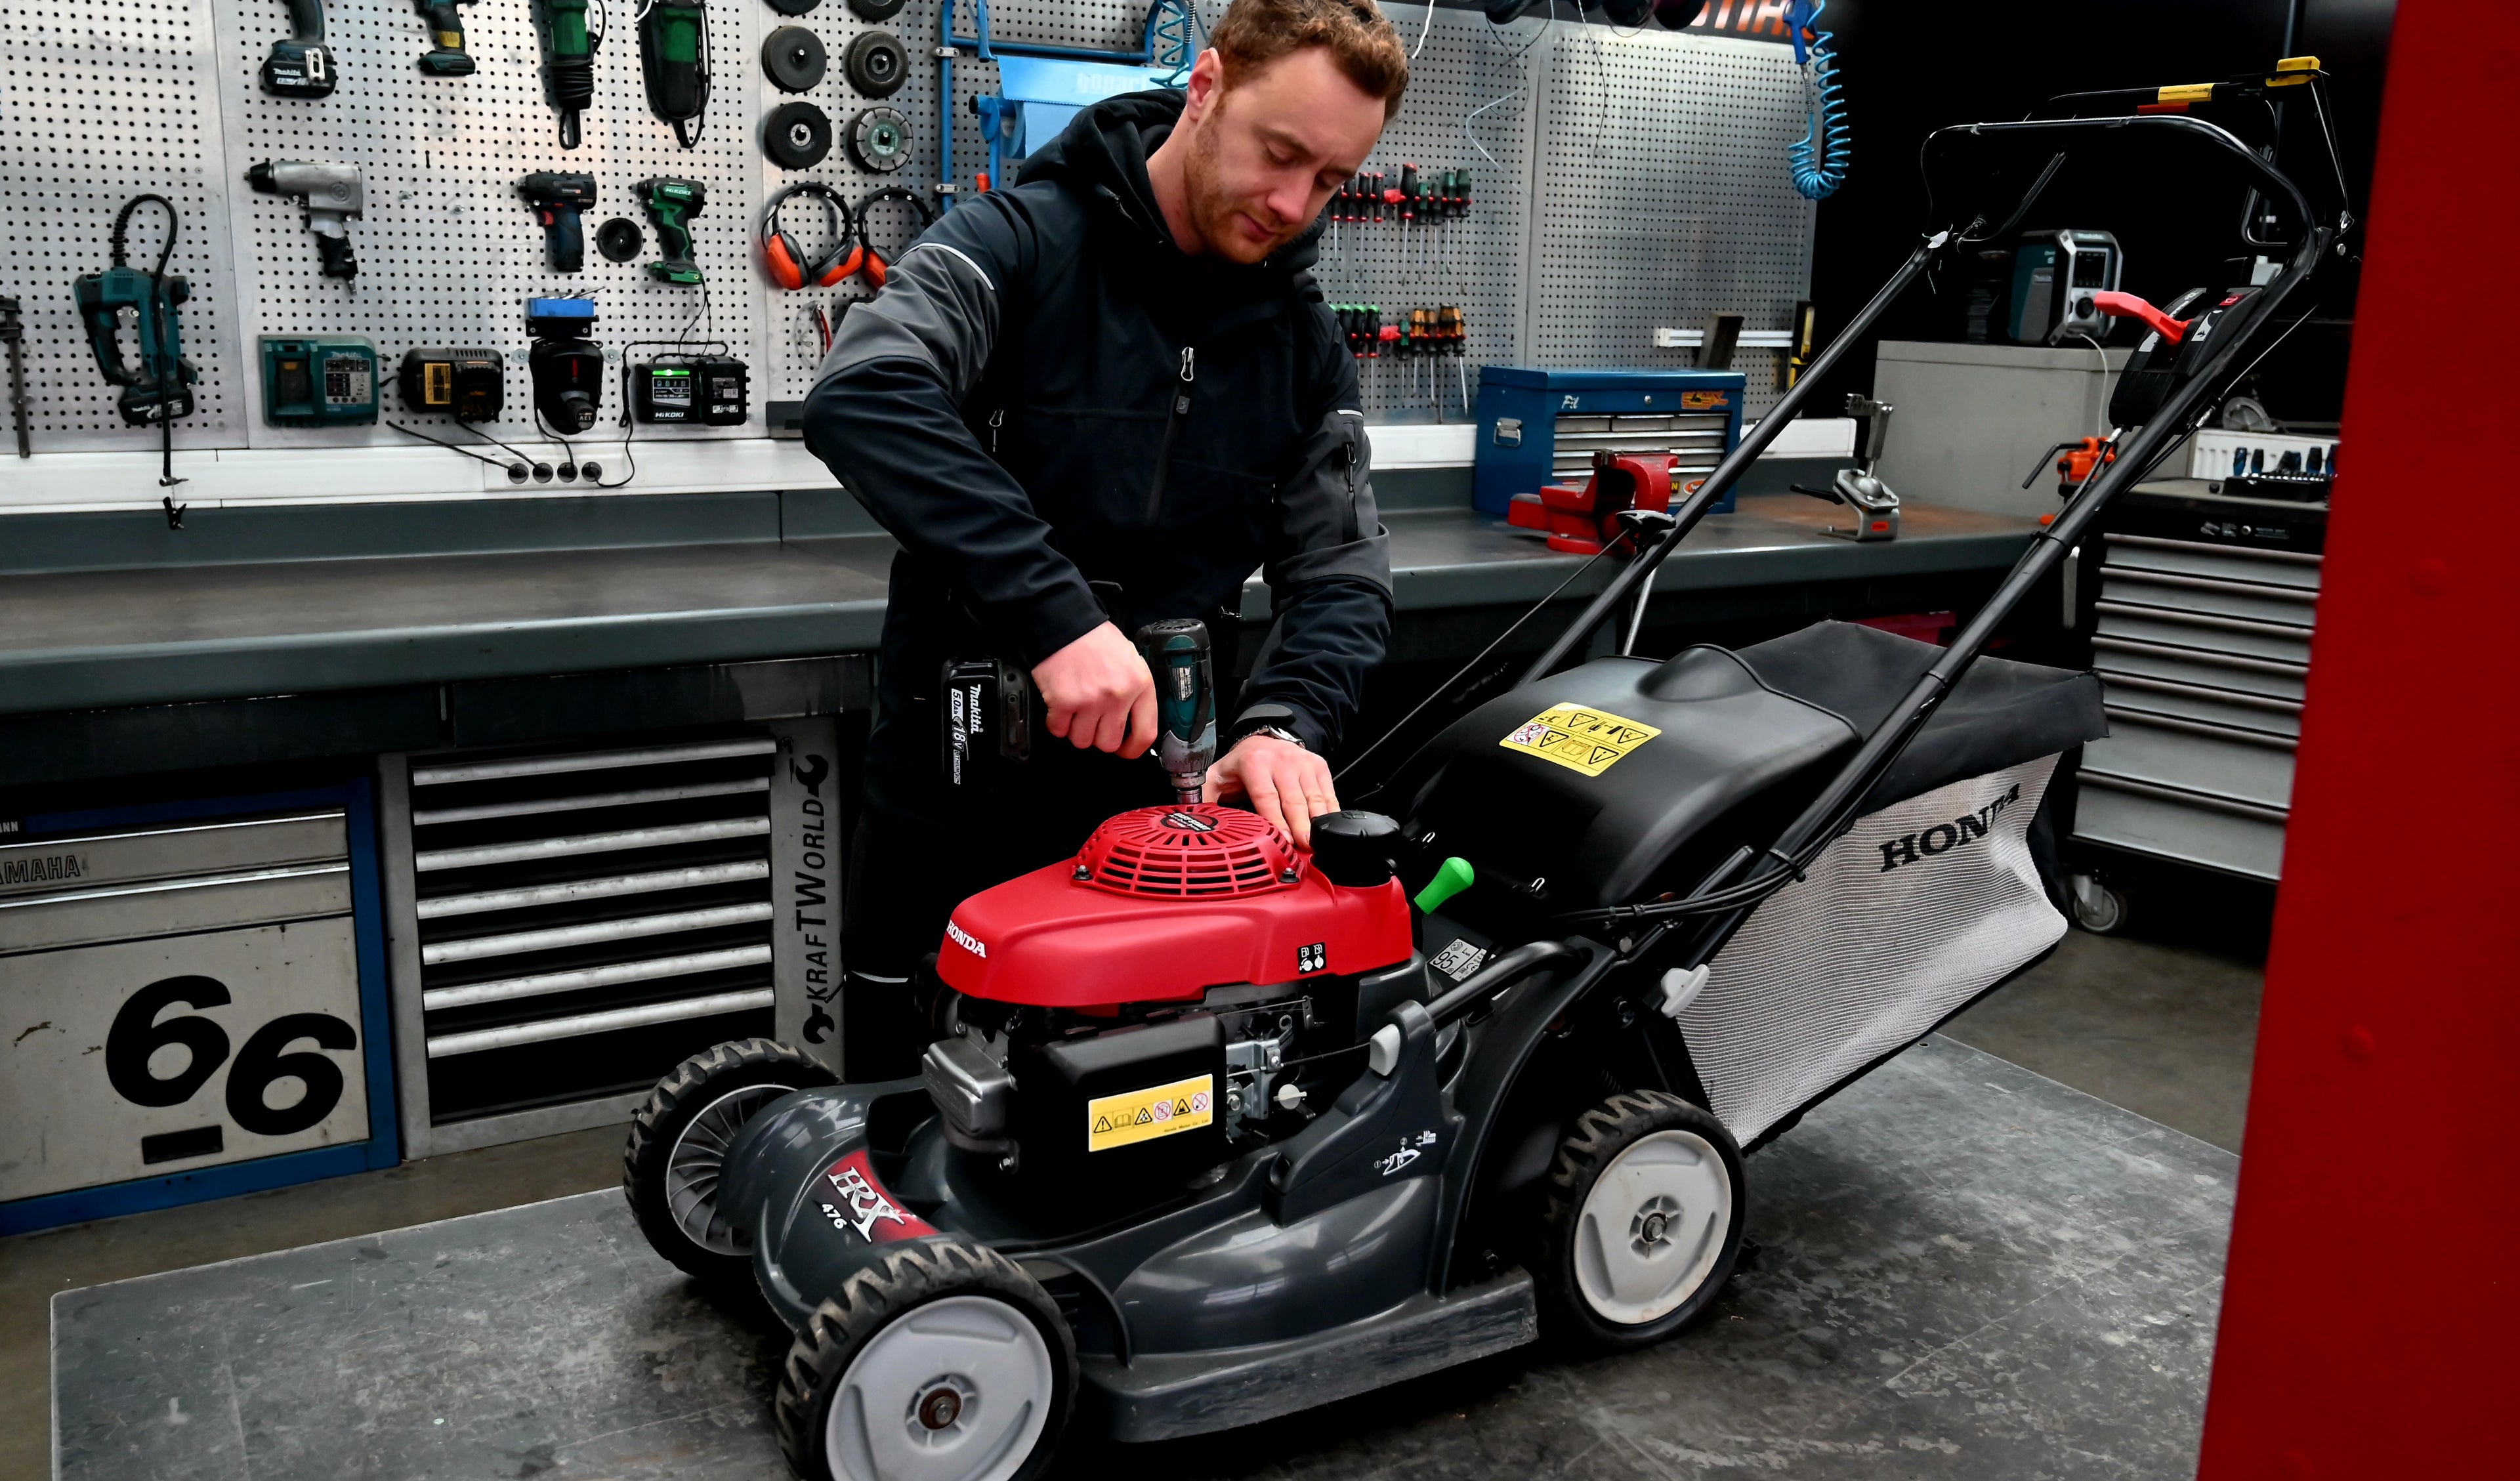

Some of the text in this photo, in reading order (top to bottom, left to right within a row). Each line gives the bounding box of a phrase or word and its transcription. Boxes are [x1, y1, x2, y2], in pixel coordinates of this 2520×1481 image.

[946, 919, 987, 959] HONDA
[1433, 951, 1459, 970] 95
[822, 1203, 848, 1230] 476
[827, 1165, 906, 1243] HRX
